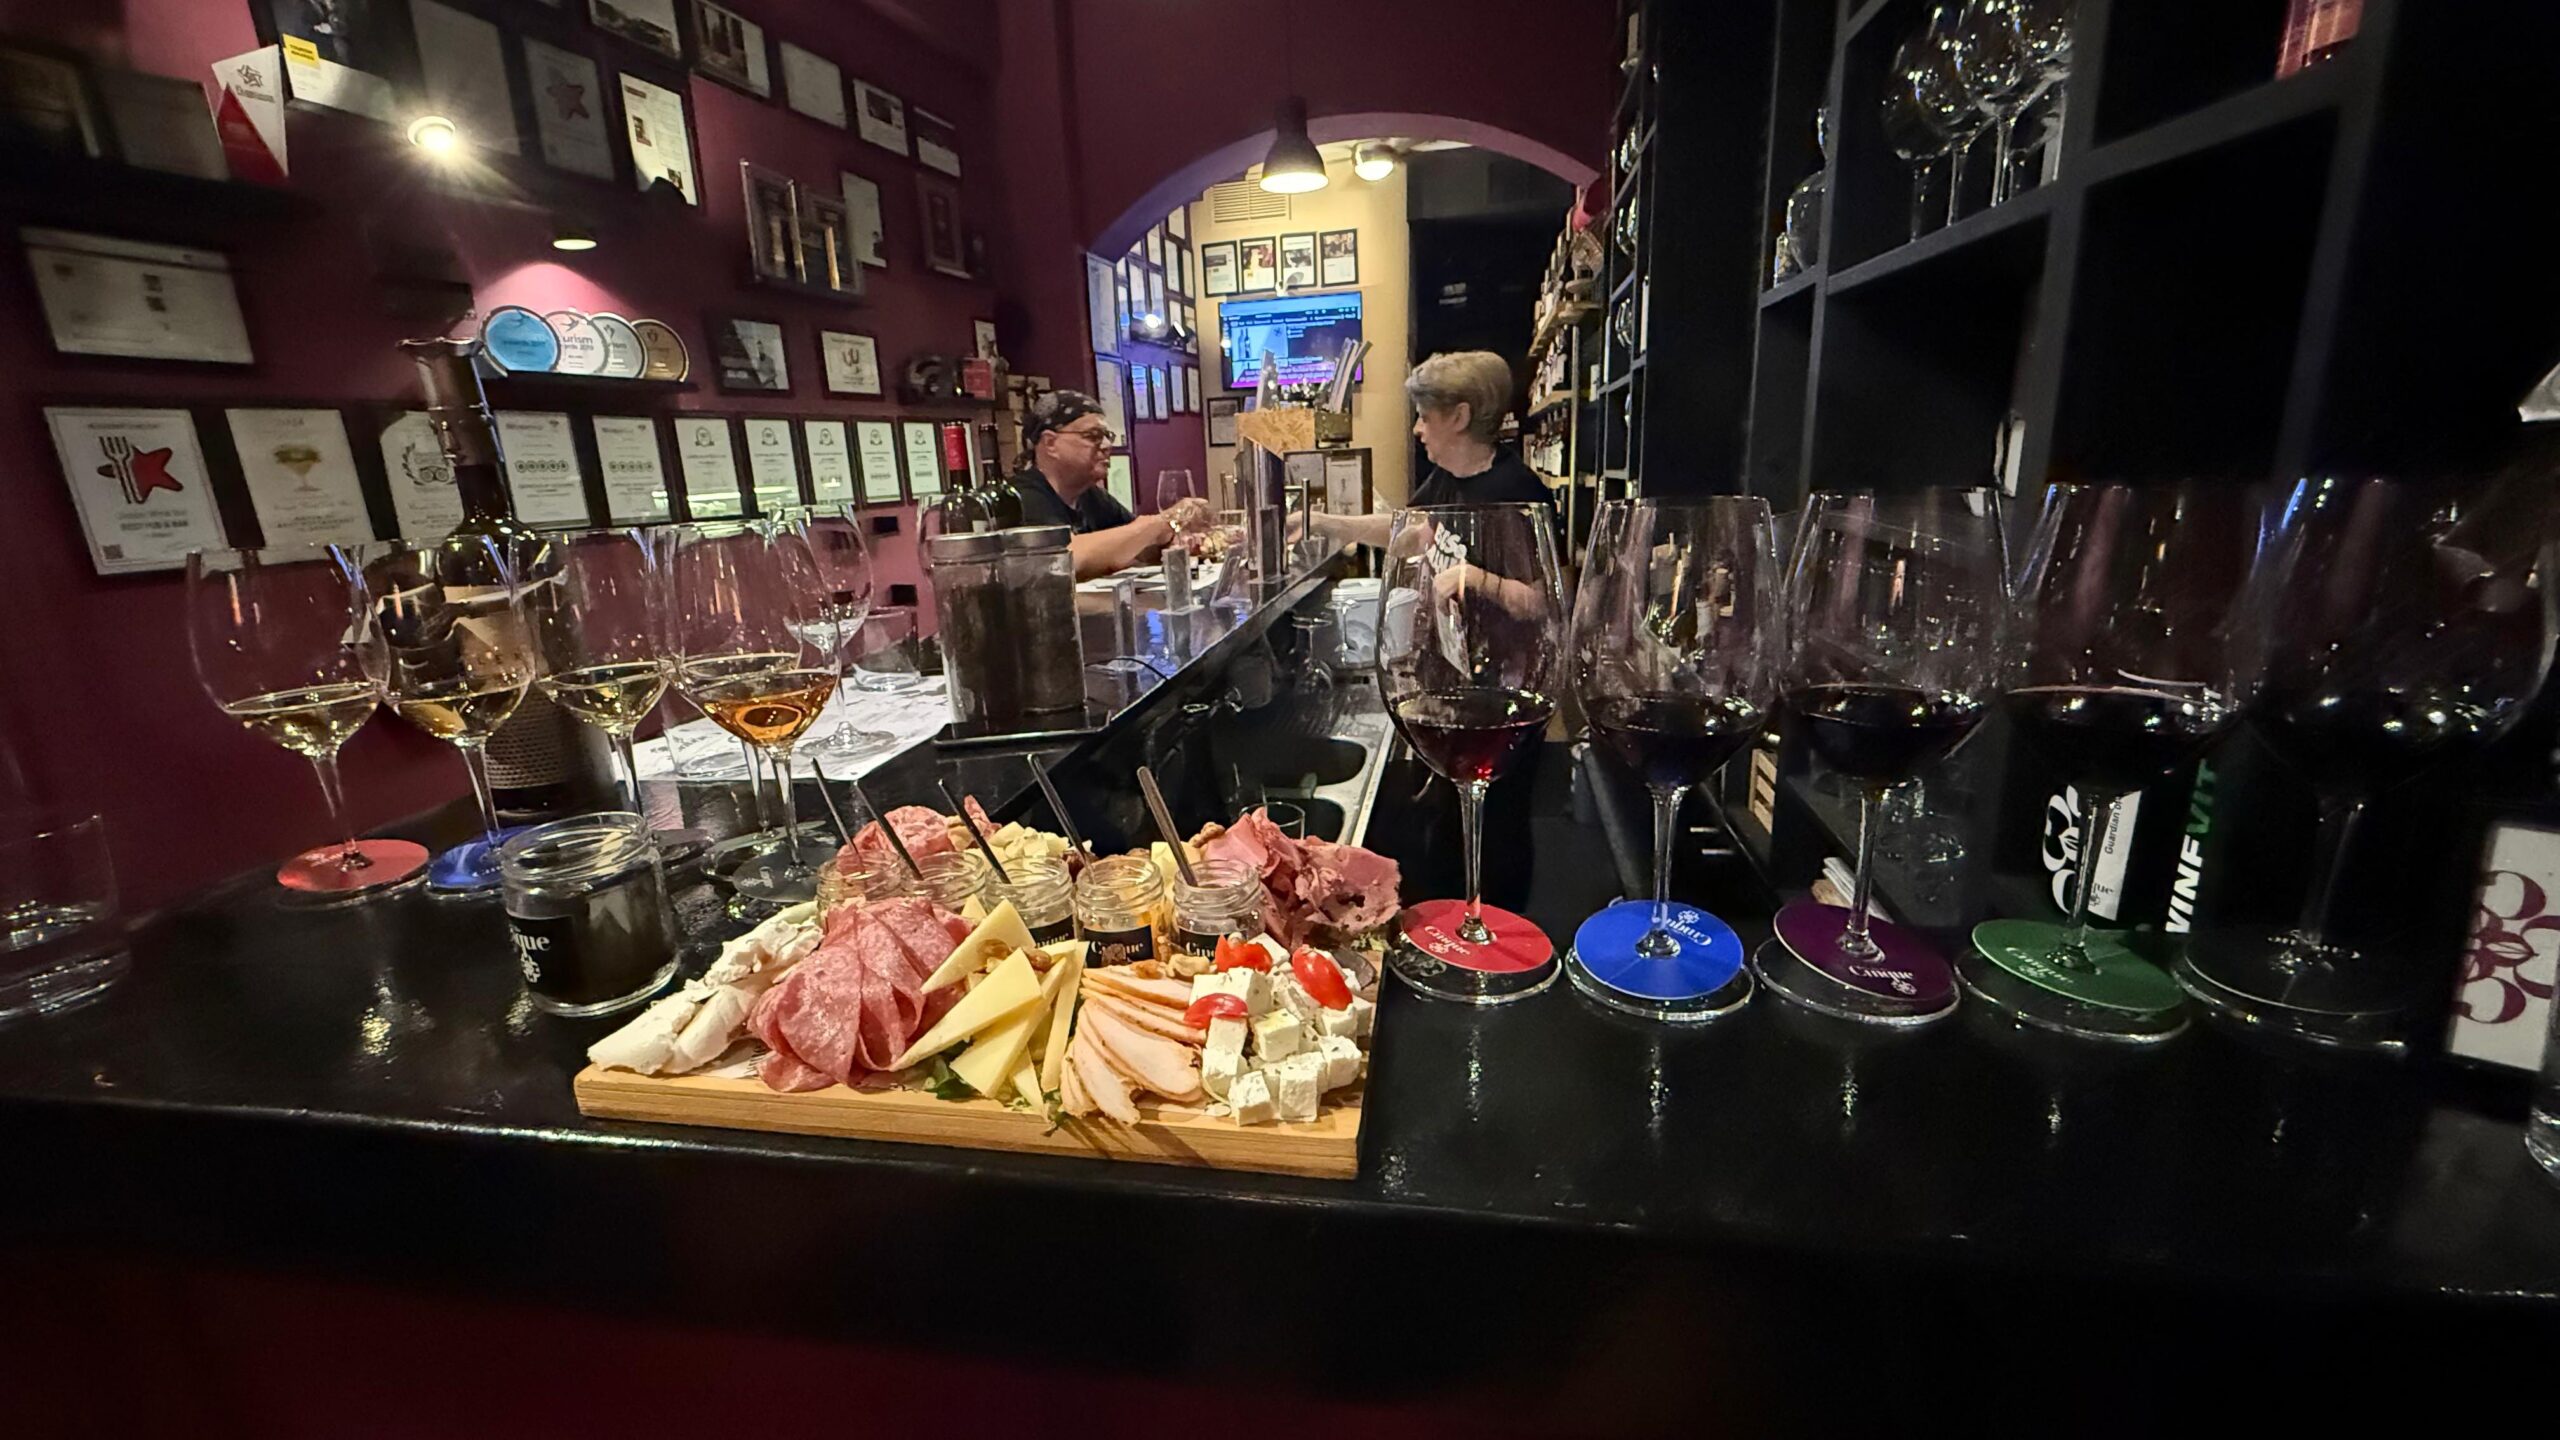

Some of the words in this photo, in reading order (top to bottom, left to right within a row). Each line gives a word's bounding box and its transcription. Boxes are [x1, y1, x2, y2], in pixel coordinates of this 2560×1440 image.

[562, 334, 593, 344] urism
[2104, 811, 2121, 855] Guardian
[509, 923, 551, 958] que
[1424, 925, 1471, 955] Cinque
[1665, 918, 1712, 946] Cinqu
[1090, 940, 1144, 955] Cue
[1185, 941, 1216, 958] Cin
[1847, 965, 1914, 984] Cinque
